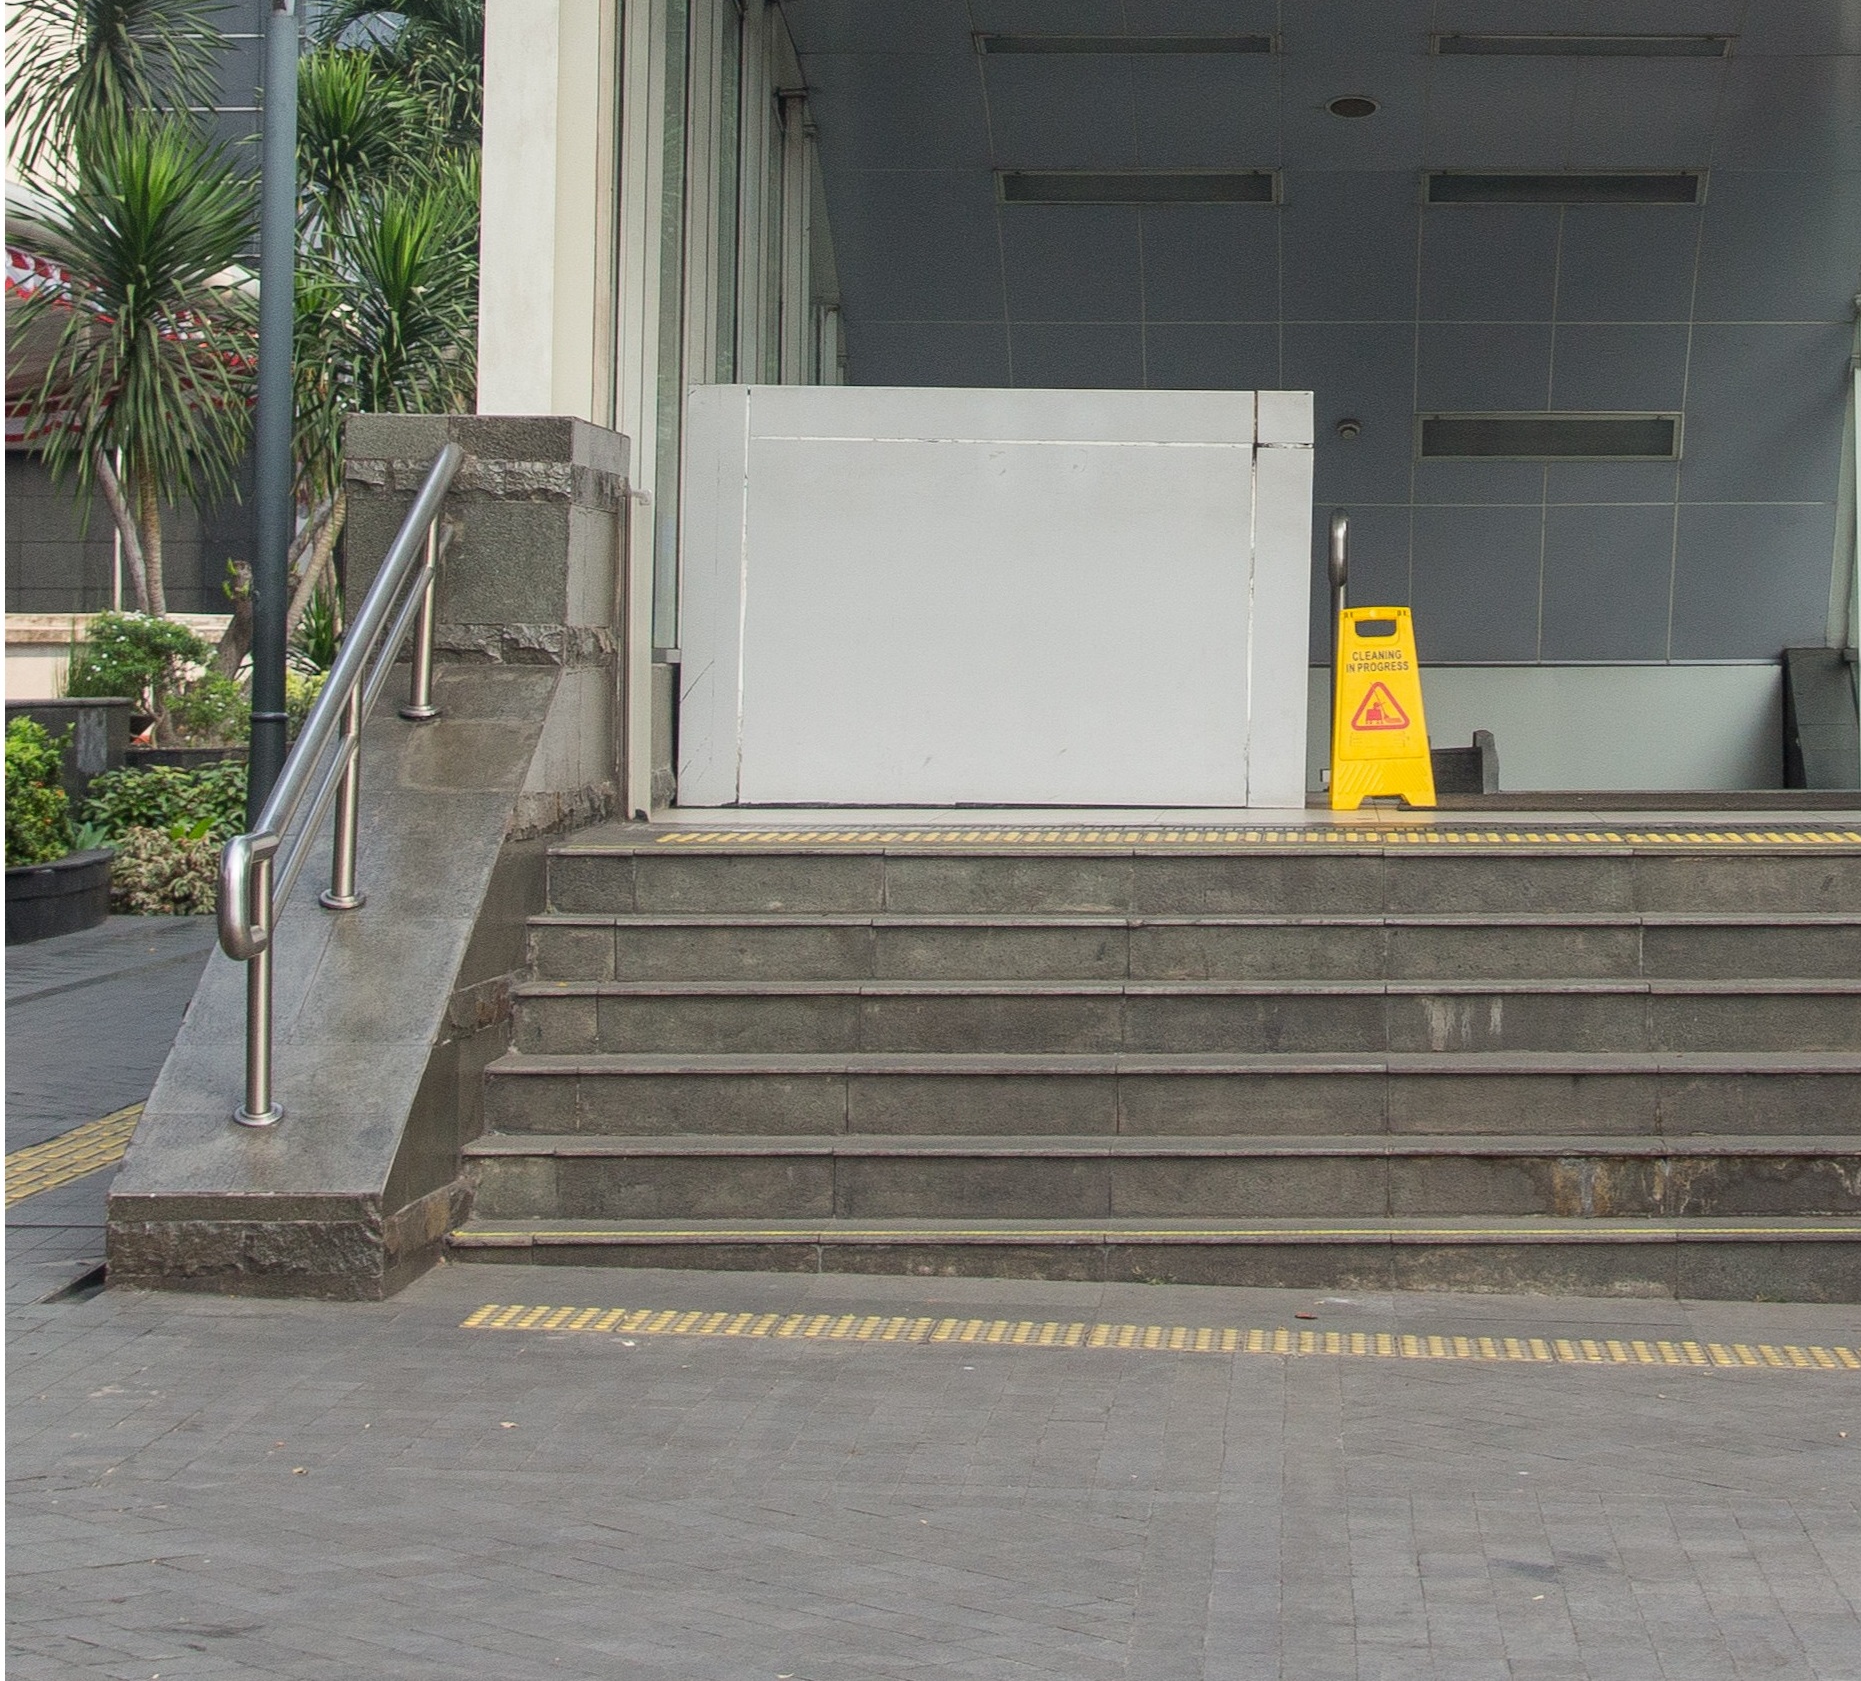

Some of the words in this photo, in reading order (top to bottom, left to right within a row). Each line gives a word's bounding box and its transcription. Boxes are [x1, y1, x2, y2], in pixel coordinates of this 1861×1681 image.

[1352, 649, 1402, 662] CLEANING
[1346, 663, 1355, 673] IN
[1357, 661, 1409, 672] PROGRESS
